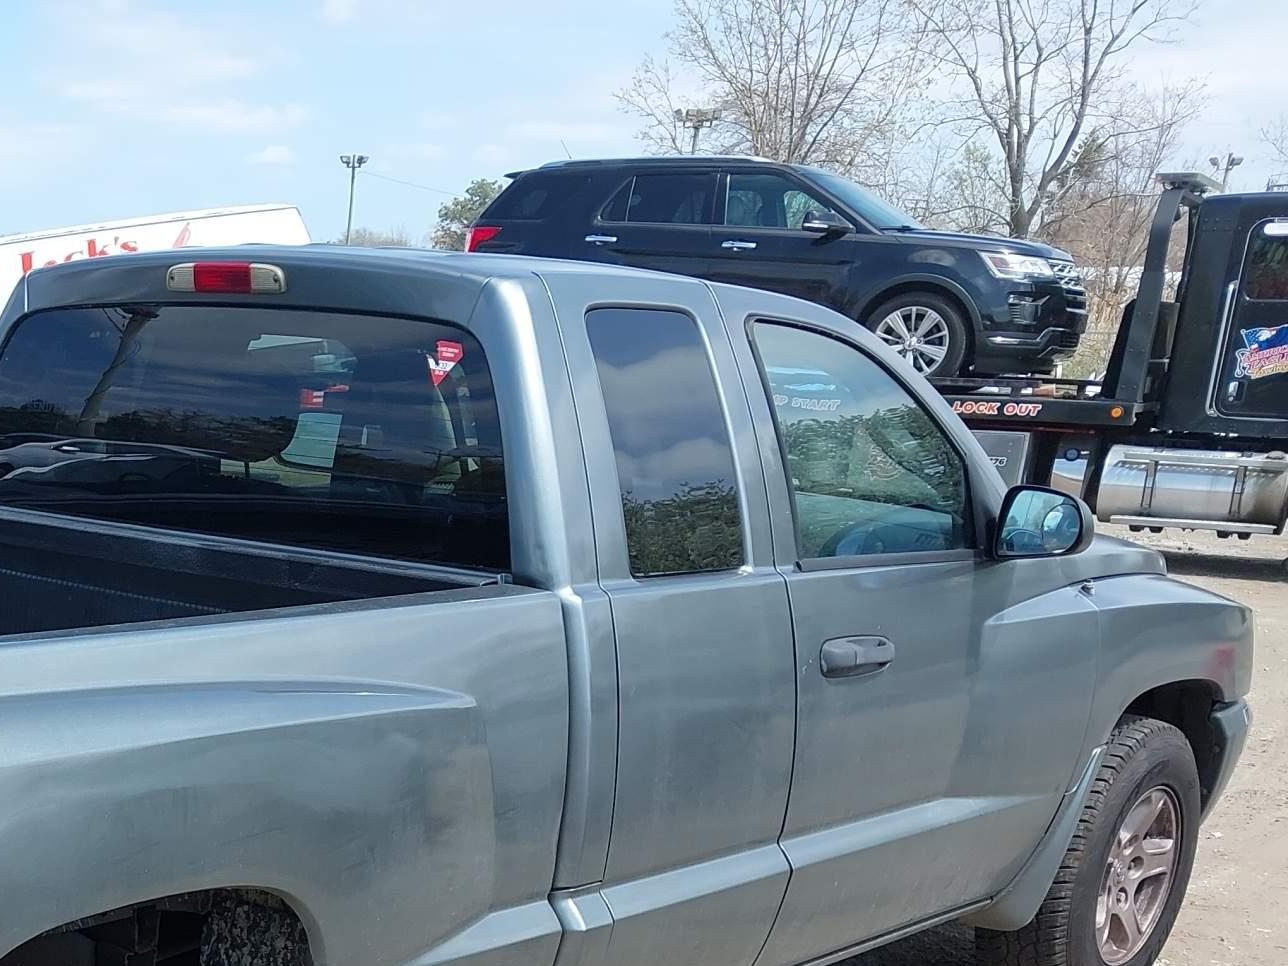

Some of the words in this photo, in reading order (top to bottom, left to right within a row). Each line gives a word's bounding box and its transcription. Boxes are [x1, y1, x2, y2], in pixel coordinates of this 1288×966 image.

[791, 397, 840, 411] START
[952, 401, 1001, 415] LOCK
[1003, 403, 1042, 416] OUT
